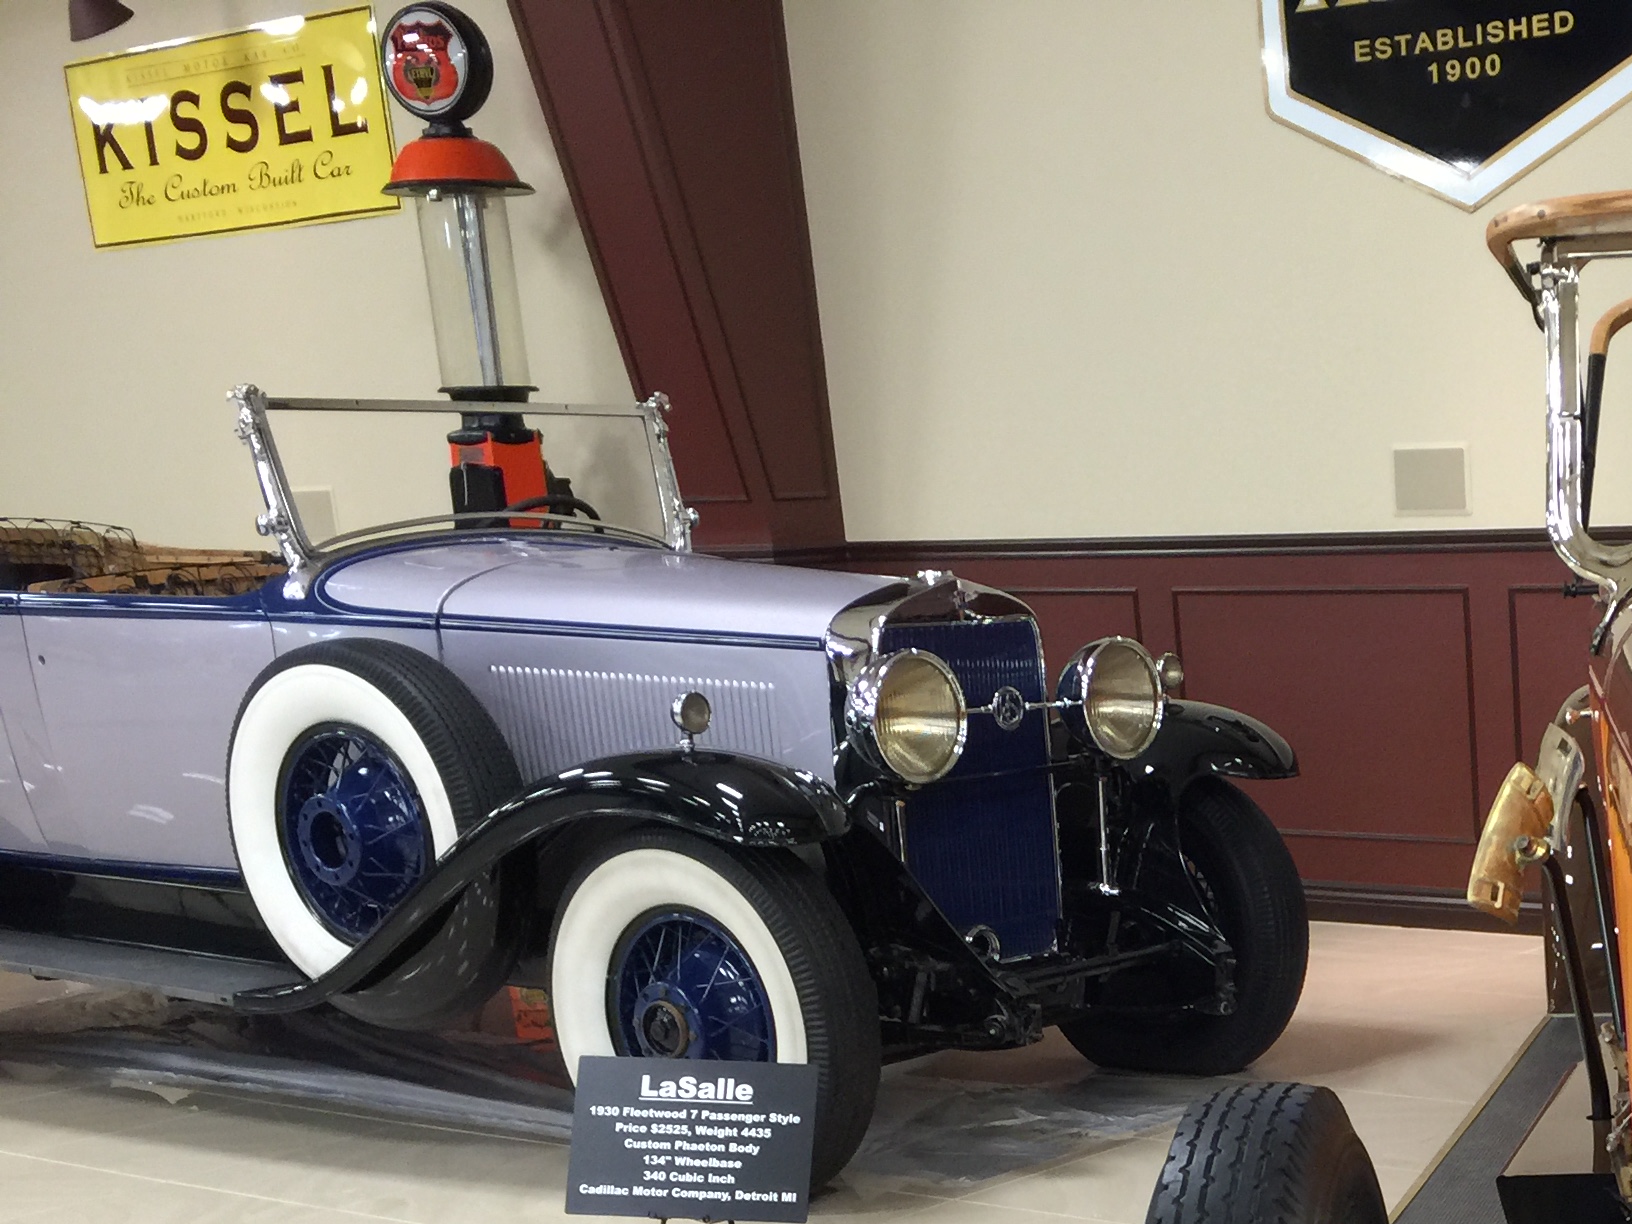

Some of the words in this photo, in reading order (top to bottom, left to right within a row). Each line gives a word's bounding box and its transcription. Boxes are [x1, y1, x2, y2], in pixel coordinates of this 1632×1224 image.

[1354, 10, 1575, 63] ESTABLISHED
[1427, 54, 1501, 85] 1900
[92, 64, 369, 174] KISSEL
[118, 181, 156, 209] The
[164, 174, 239, 202] Custom
[248, 158, 304, 191] Built
[313, 150, 353, 180] Car
[640, 1075, 753, 1101] LaSalle
[590, 1106, 619, 1116] 1930
[623, 1107, 687, 1118] Fleetwood
[690, 1110, 698, 1119] 7
[701, 1110, 766, 1123] Passenger
[769, 1113, 800, 1125] Style
[615, 1122, 647, 1133] Price
[650, 1124, 691, 1136] $2525,
[695, 1126, 738, 1138] Weight
[741, 1128, 771, 1138] 4435
[624, 1139, 671, 1149] Custom
[675, 1141, 725, 1152] Phaeton
[729, 1143, 760, 1155] Body
[675, 1156, 742, 1168] Wheelbase
[643, 1171, 666, 1181] 340
[669, 1172, 704, 1182] Cubic
[708, 1173, 734, 1183] Inch
[579, 1184, 629, 1195] Cadillac
[633, 1186, 669, 1196] Motor
[672, 1188, 731, 1201] Company,
[735, 1190, 778, 1201] Detroit
[782, 1192, 796, 1202] MI
